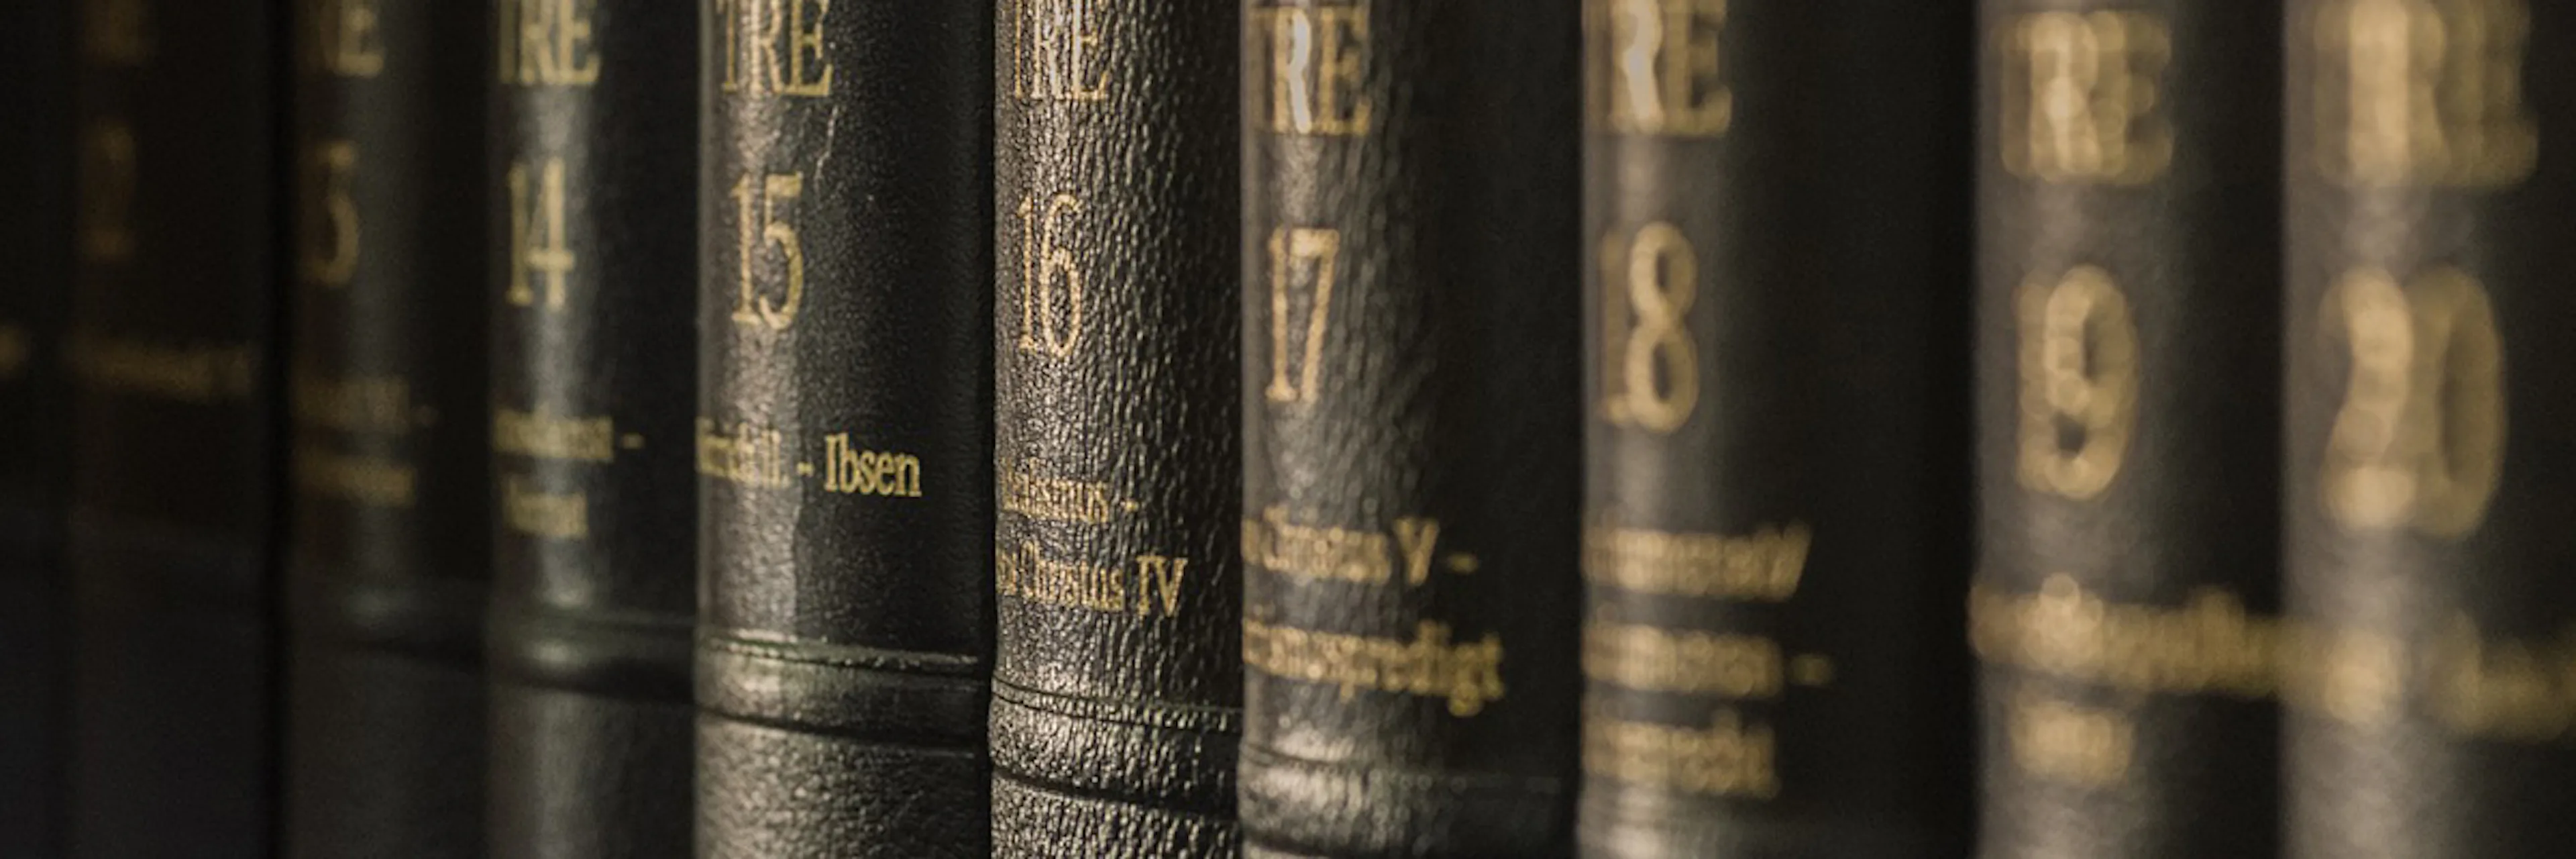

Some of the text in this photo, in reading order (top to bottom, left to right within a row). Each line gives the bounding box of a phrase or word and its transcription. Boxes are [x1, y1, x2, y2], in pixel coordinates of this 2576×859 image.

[716, 0, 833, 97] TRE
[1248, 5, 1371, 135] TRE
[1994, 9, 2175, 185] TRE
[505, 157, 575, 310] 14
[729, 170, 804, 330] 15
[1017, 192, 1081, 358] 16
[1265, 227, 1340, 403] 17
[1601, 220, 1699, 433] 18
[2016, 263, 2140, 500] 19
[823, 432, 922, 498] Ibsen
[2318, 266, 2510, 537] 20
[1135, 552, 1188, 617] IV
[1393, 517, 1440, 587] V
